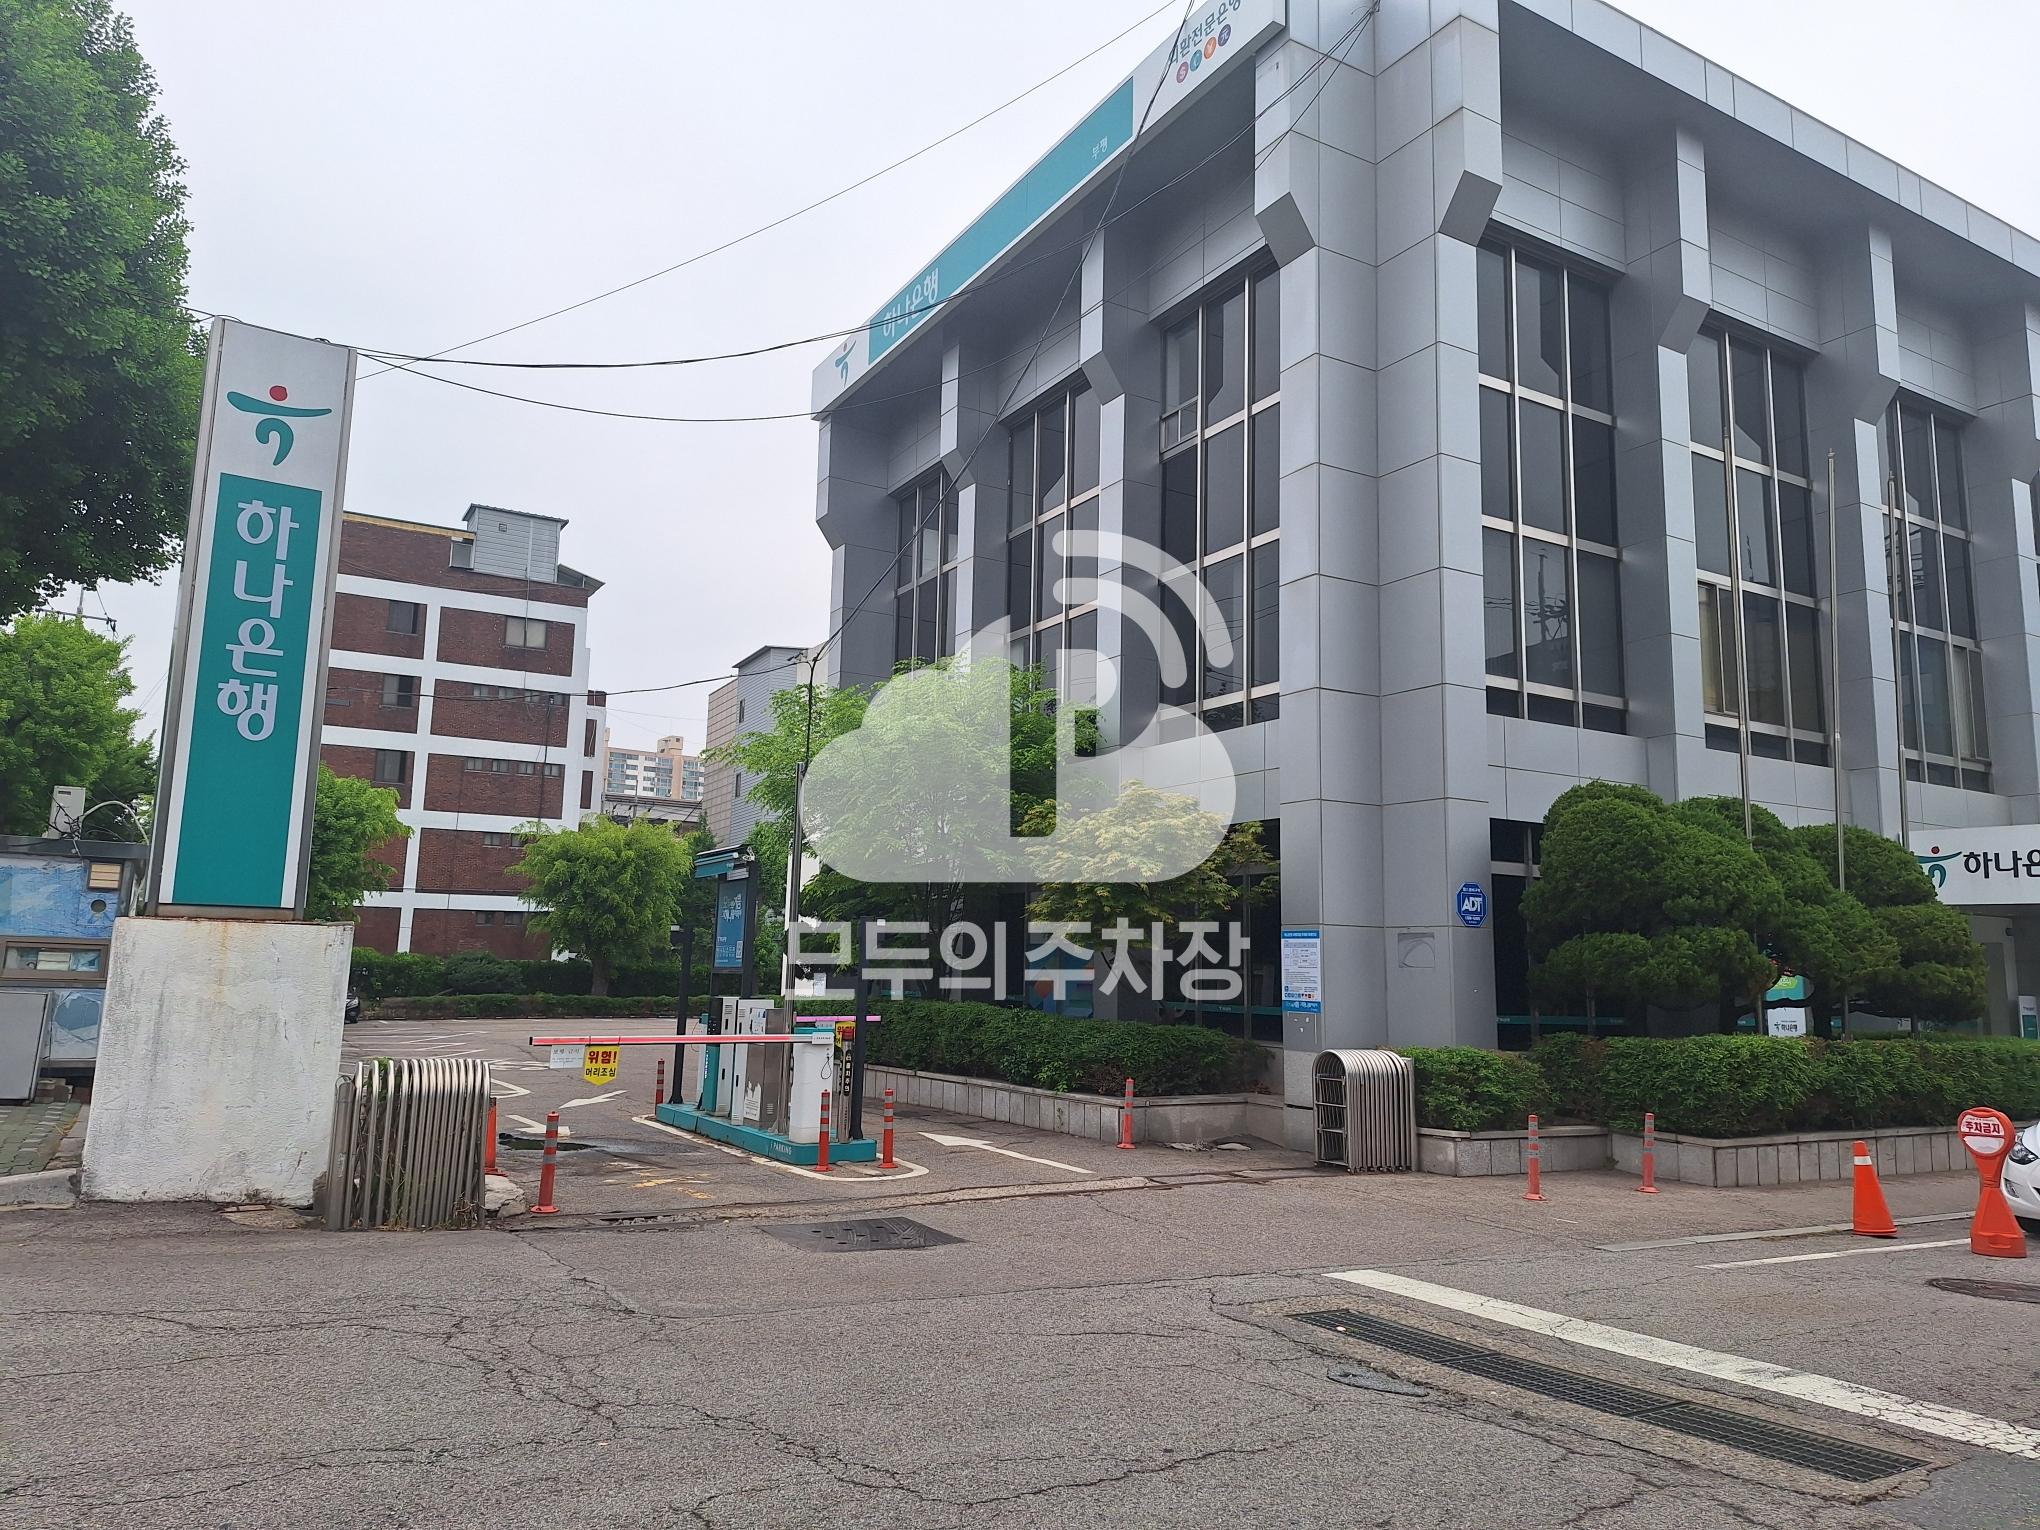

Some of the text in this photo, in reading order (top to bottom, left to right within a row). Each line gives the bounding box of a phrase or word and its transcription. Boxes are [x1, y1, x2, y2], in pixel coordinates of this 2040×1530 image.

[883, 267, 939, 337] 하나은행
[217, 499, 300, 741] 하나은행
[1461, 896, 1483, 912] ADT
[587, 1050, 618, 1064] 위험!
[585, 1067, 616, 1077] 머리조심
[1965, 1121, 2001, 1135] 주차금지
